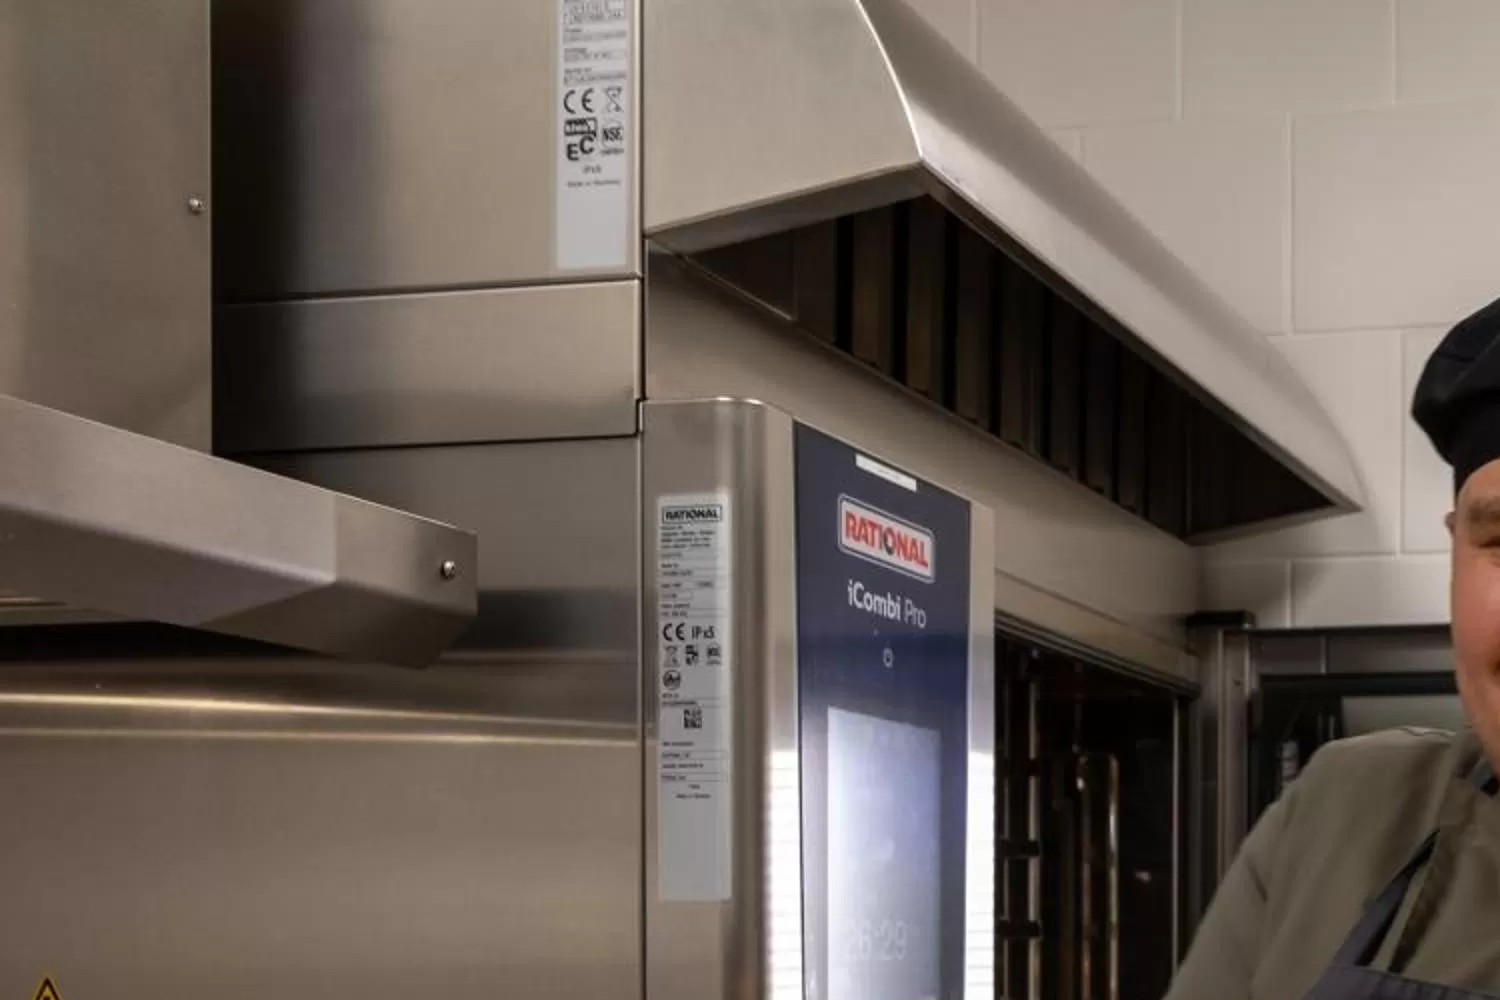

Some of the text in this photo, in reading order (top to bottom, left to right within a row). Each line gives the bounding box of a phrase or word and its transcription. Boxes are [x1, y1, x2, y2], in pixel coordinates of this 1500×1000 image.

[664, 508, 718, 520] RATIONAL
[845, 510, 929, 568] RATIONAL
[847, 578, 927, 629] iCombi Pro
